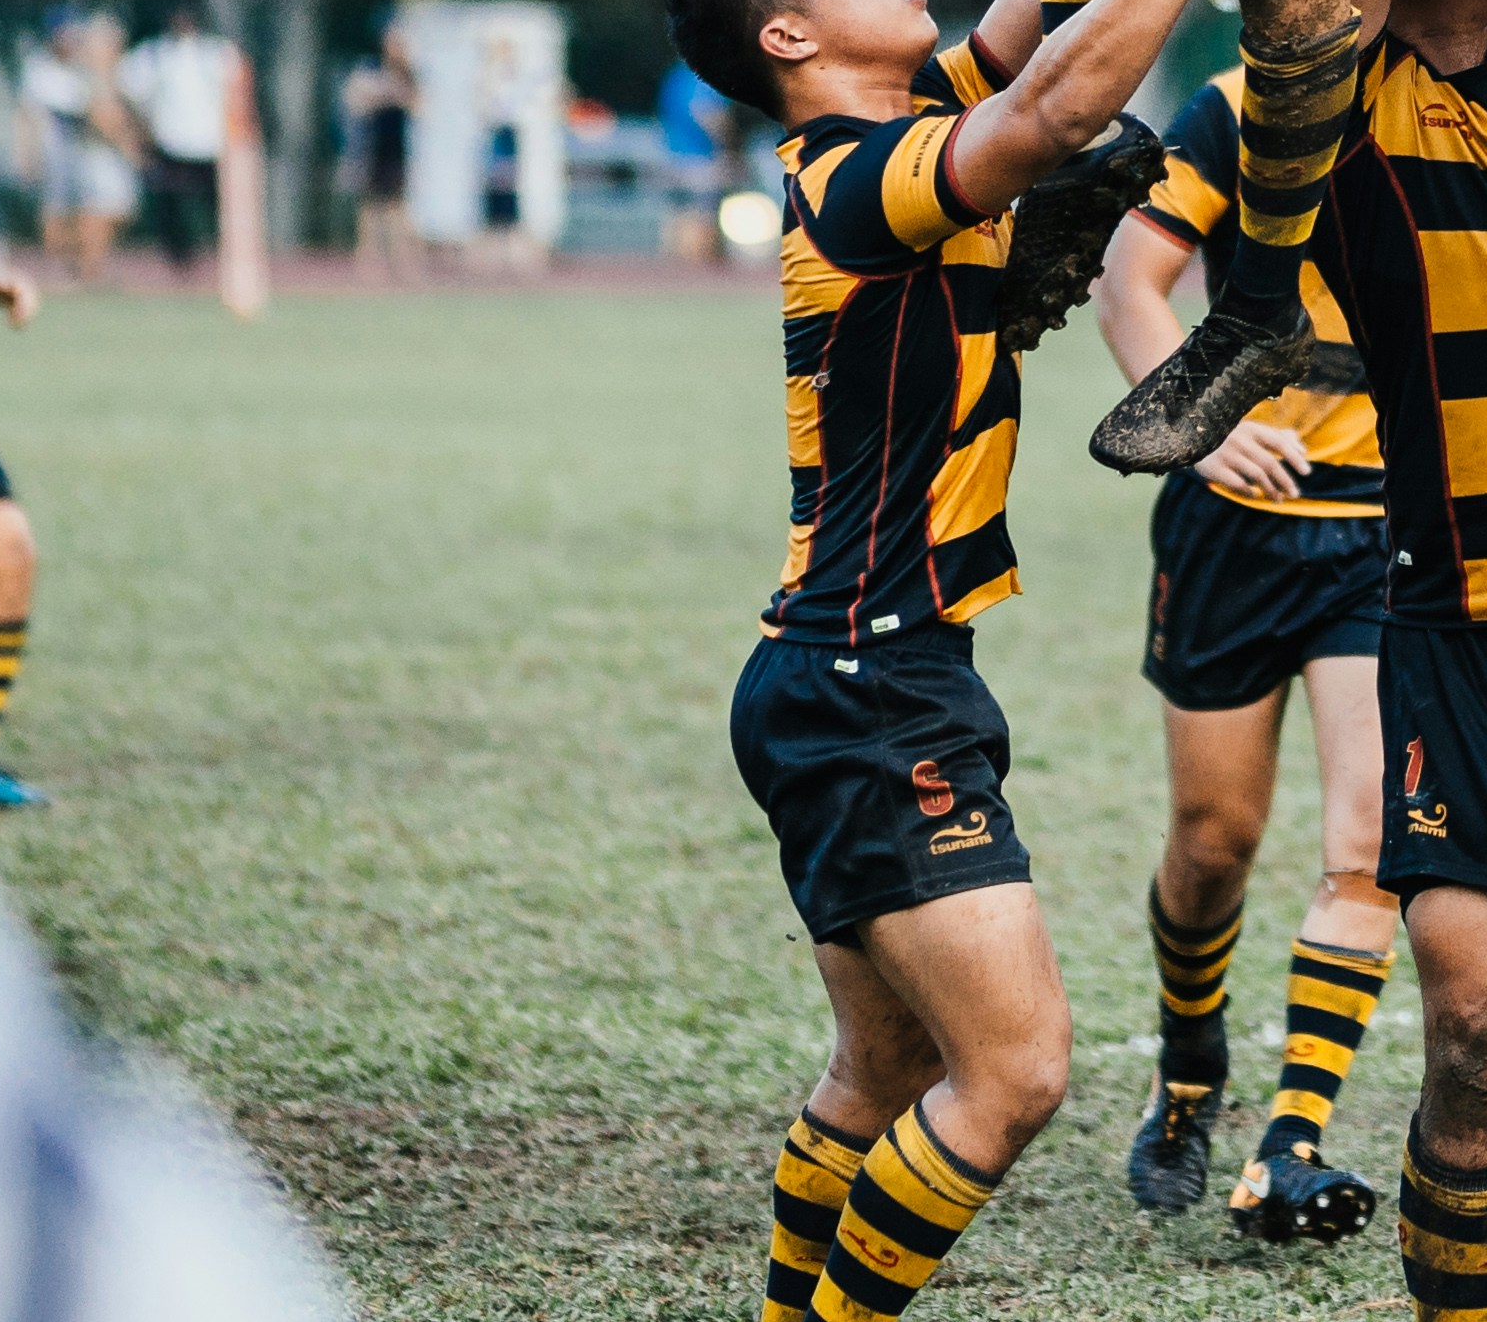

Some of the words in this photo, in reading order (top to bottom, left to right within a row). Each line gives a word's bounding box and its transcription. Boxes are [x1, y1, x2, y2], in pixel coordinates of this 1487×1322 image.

[912, 759, 954, 817] 6
[1404, 735, 1424, 797] 1
[929, 831, 993, 855] tsunami
